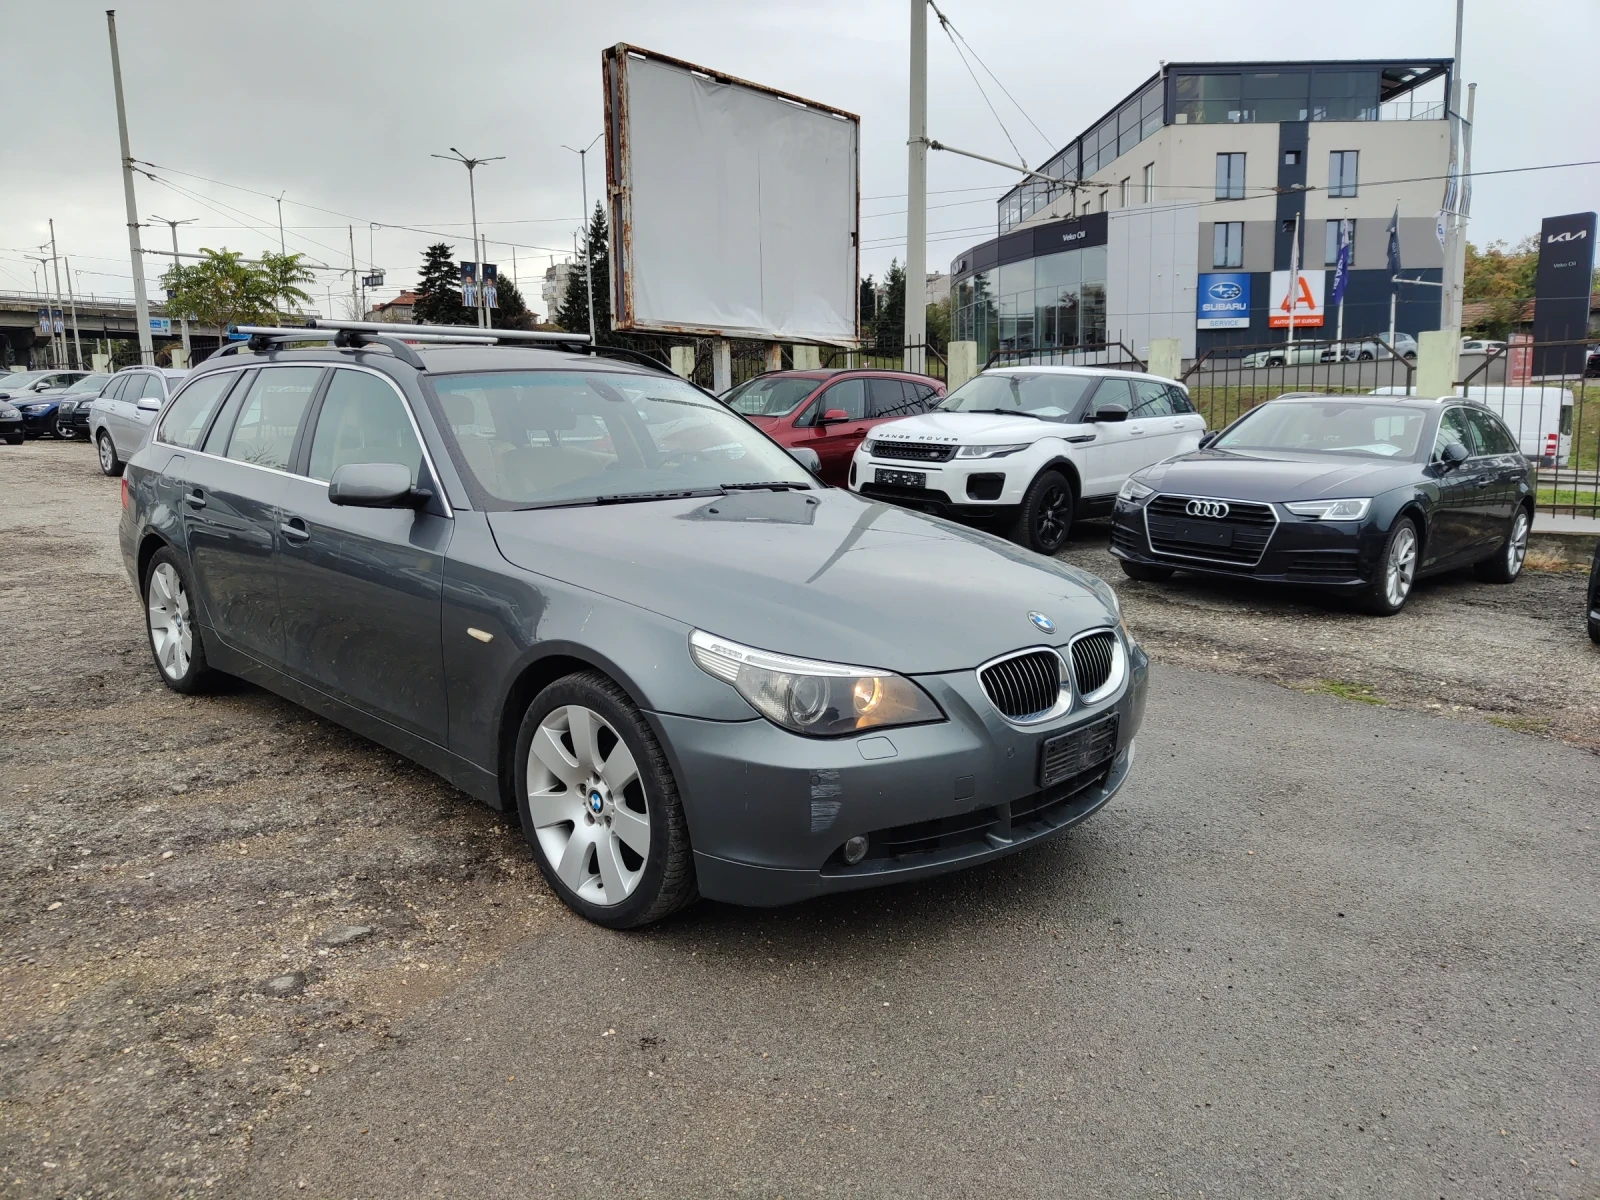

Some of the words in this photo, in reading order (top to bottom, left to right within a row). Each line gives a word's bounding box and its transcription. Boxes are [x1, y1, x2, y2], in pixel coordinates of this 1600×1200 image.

[1062, 233, 1076, 241] Veko
[1077, 230, 1086, 239] Oil
[1547, 230, 1586, 243] KIA
[1202, 302, 1247, 311] SUBARU
